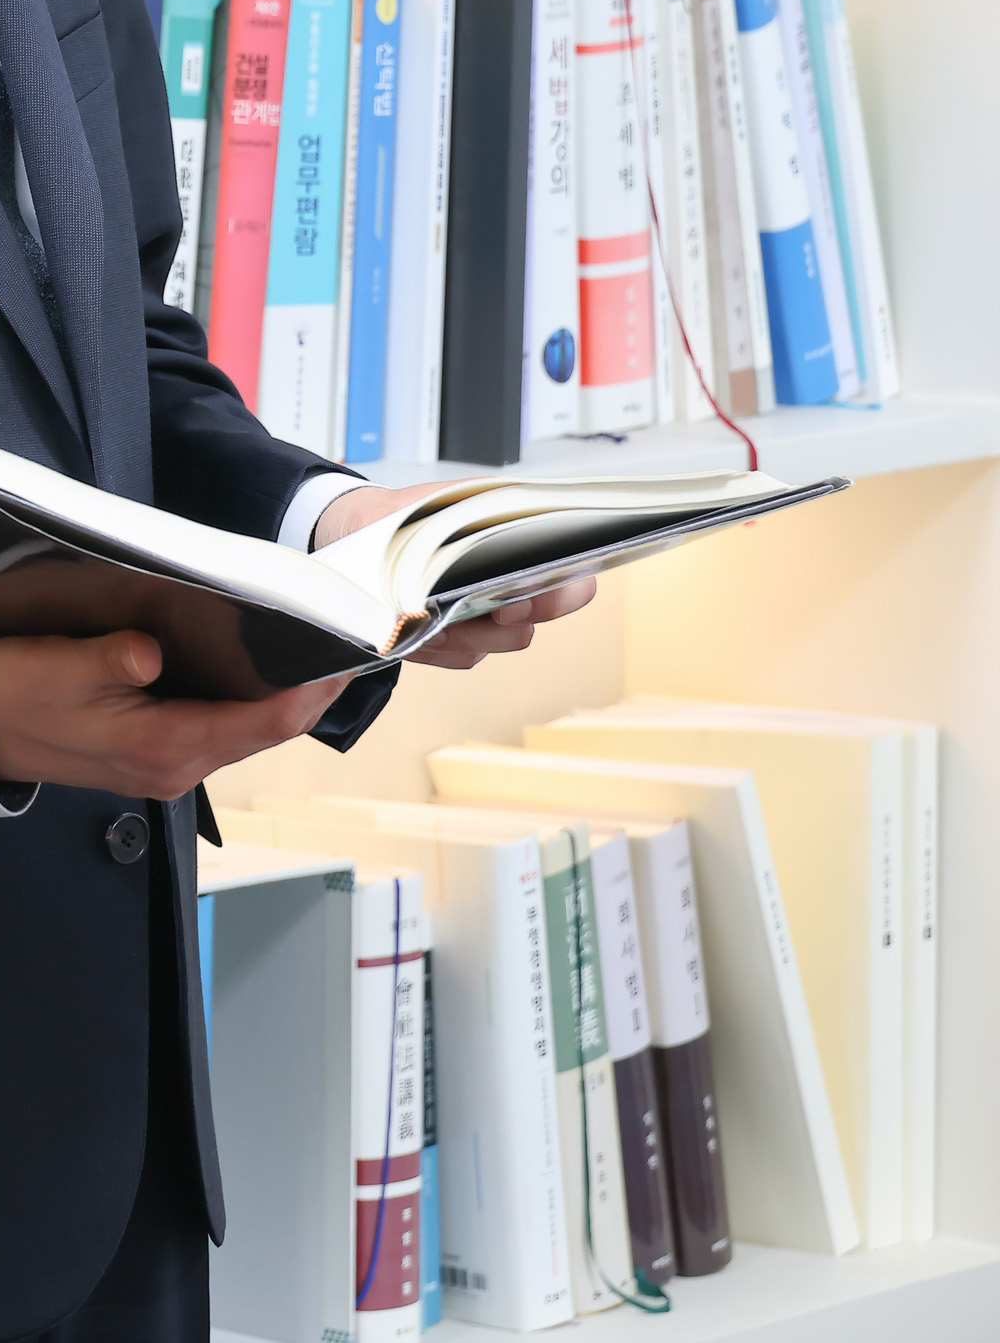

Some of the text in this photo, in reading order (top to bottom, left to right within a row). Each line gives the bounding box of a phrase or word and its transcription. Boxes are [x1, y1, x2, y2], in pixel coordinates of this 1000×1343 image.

[231, 99, 281, 127] 관계법
[373, 42, 396, 117] 신탁법
[548, 35, 570, 198] 세법강의
[295, 134, 321, 257] 업무편람
